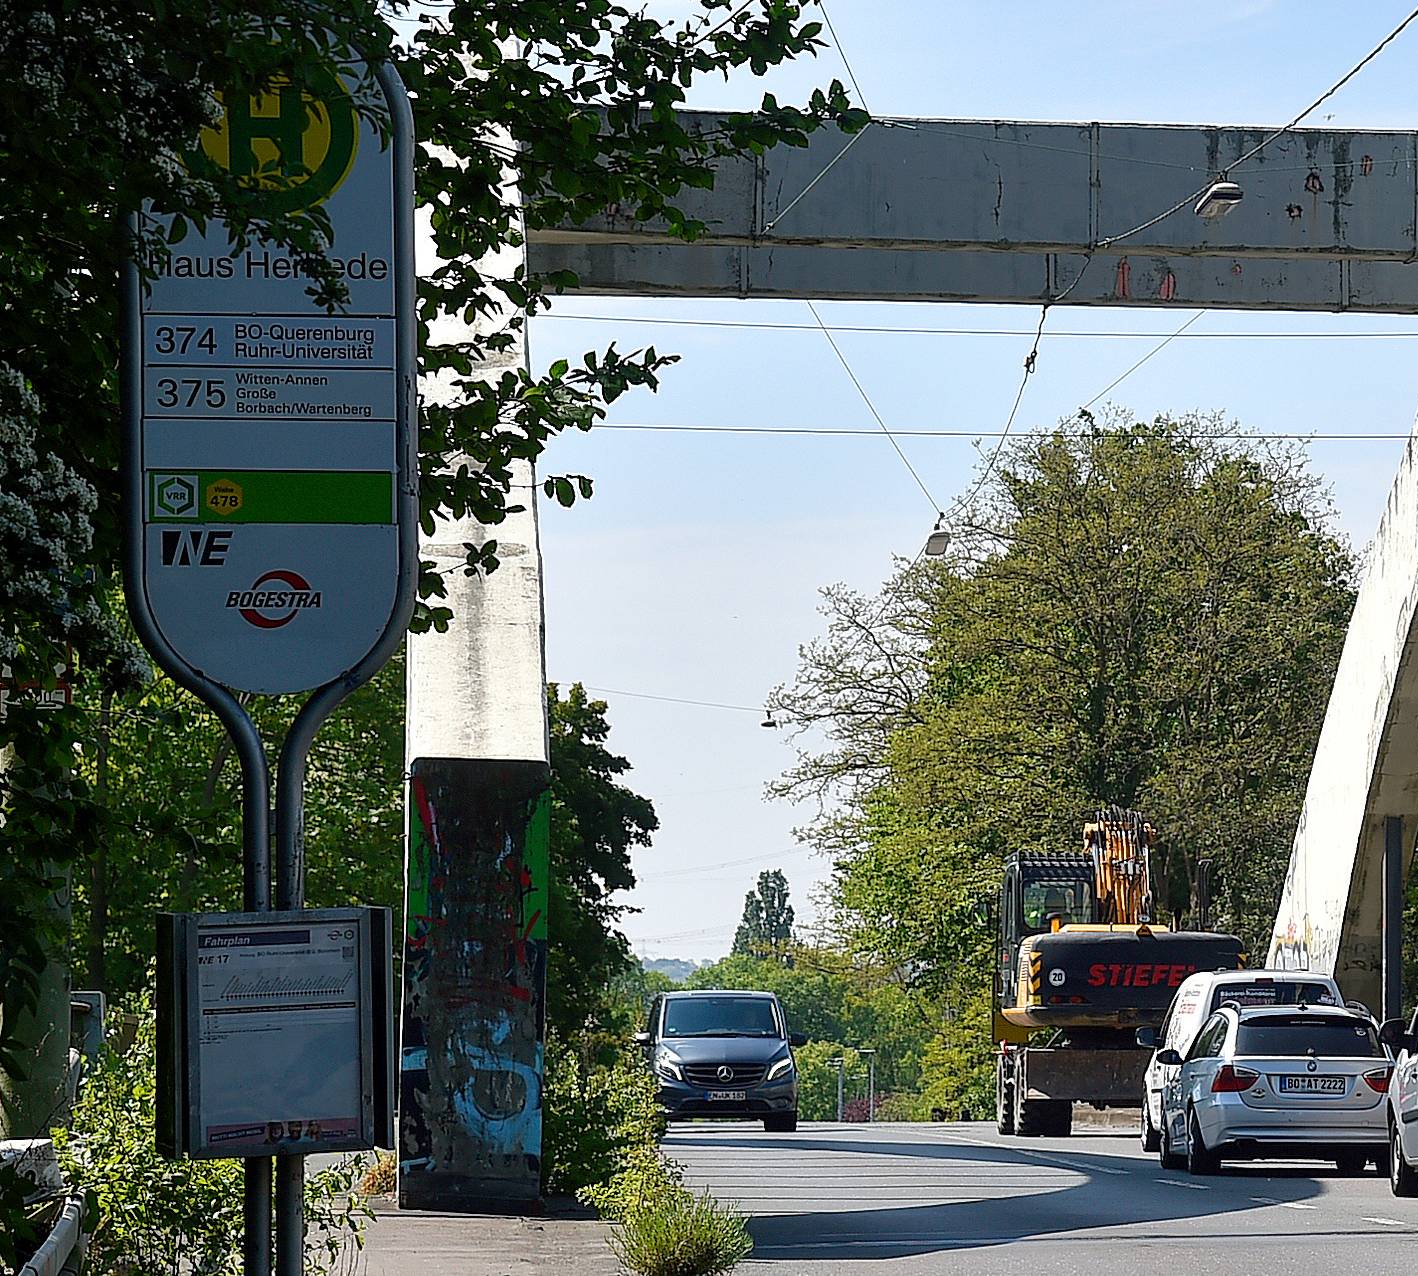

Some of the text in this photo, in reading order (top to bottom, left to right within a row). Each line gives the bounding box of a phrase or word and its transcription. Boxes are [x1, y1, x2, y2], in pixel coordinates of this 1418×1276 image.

[228, 80, 303, 175] H
[148, 251, 388, 280] Haus Herede
[155, 326, 218, 355] 374
[235, 323, 375, 344] BO-Querenburg
[235, 343, 374, 360] Ruhr-Universität
[236, 372, 328, 386] Witten-Annen
[157, 379, 226, 408] 375
[236, 388, 277, 400] Große
[236, 402, 372, 417] Borbach/Wartenberg
[166, 491, 187, 501] VRR
[210, 495, 239, 507] 478
[225, 591, 322, 608] BOGESTRA
[204, 936, 251, 948] Fahrplan
[217, 954, 230, 965] 17
[1052, 972, 1063, 982] 20
[1088, 963, 1197, 987] STIEFE
[1288, 1078, 1344, 1090] BO AT 2222
